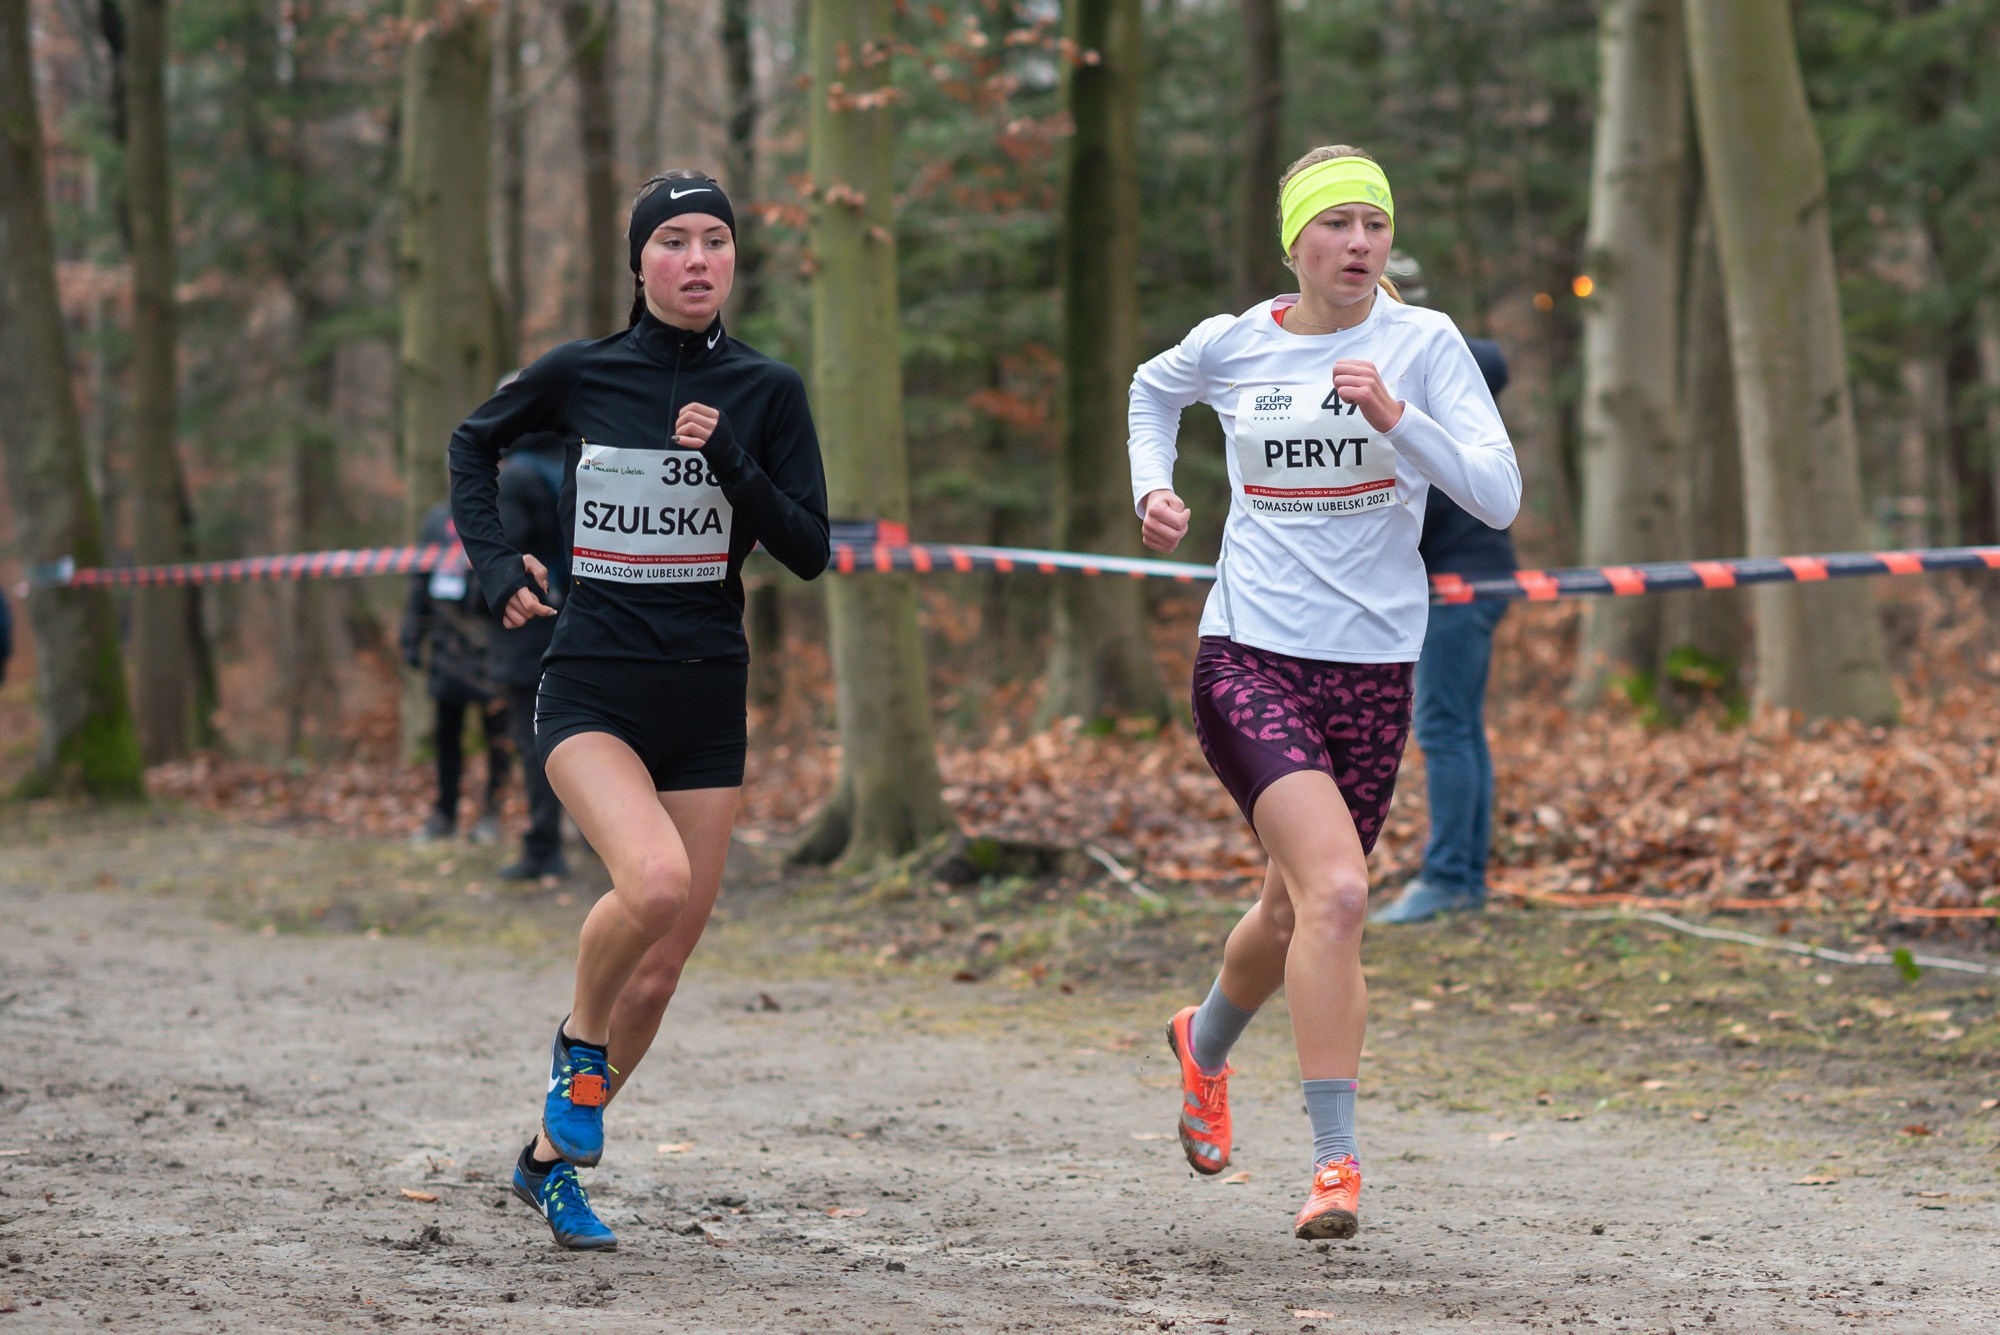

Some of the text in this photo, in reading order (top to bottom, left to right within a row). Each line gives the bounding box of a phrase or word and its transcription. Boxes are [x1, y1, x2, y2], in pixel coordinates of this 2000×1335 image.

[1264, 438, 1369, 468] PERYT
[1252, 492, 1390, 512] TOMASZÓW LUBELSKI 2021
[582, 500, 723, 536] SZULSKA
[580, 561, 721, 579] TOMASZÓW LUBELSKI 2021
